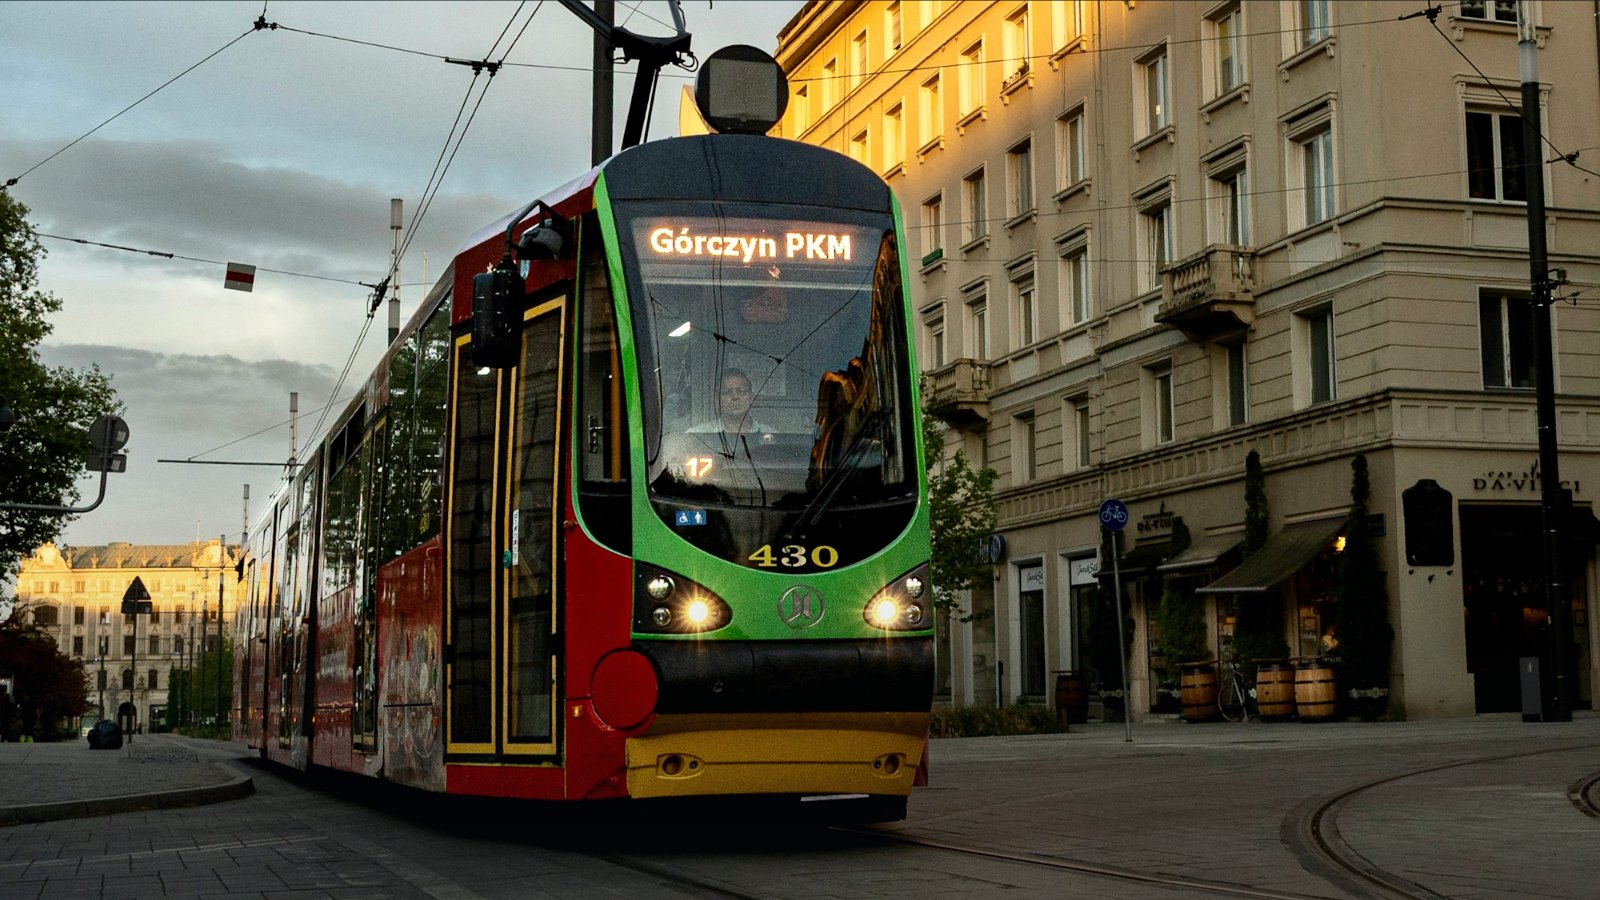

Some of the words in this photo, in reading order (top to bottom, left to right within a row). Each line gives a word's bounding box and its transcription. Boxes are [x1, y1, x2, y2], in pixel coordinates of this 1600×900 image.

[650, 228, 776, 263] Górczyn
[786, 232, 851, 260] PKM
[685, 457, 713, 477] 17
[748, 544, 839, 568] 430
